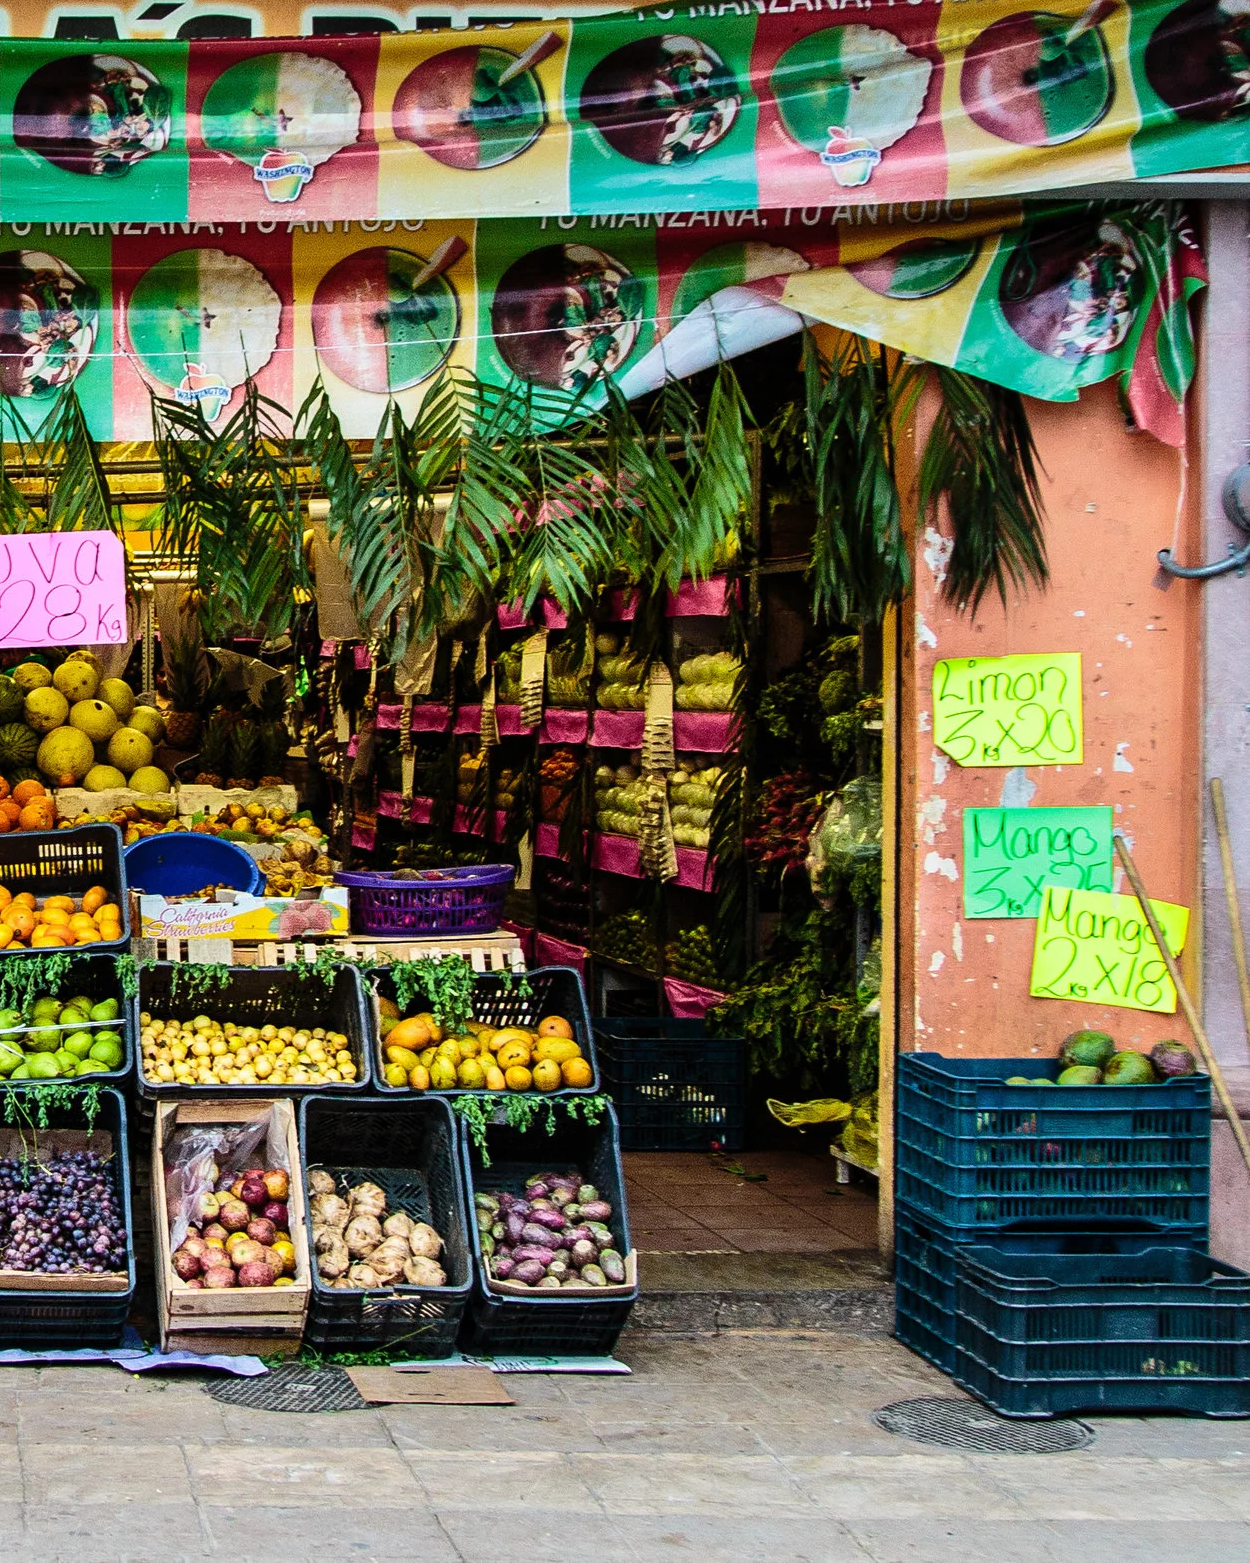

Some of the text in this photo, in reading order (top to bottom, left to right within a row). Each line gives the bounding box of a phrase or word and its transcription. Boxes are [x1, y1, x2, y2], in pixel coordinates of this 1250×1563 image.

[257, 164, 311, 179] WASHINGTON
[973, 812, 1098, 867] Mango
[159, 906, 229, 926] California
[146, 919, 236, 938] Strawberries
